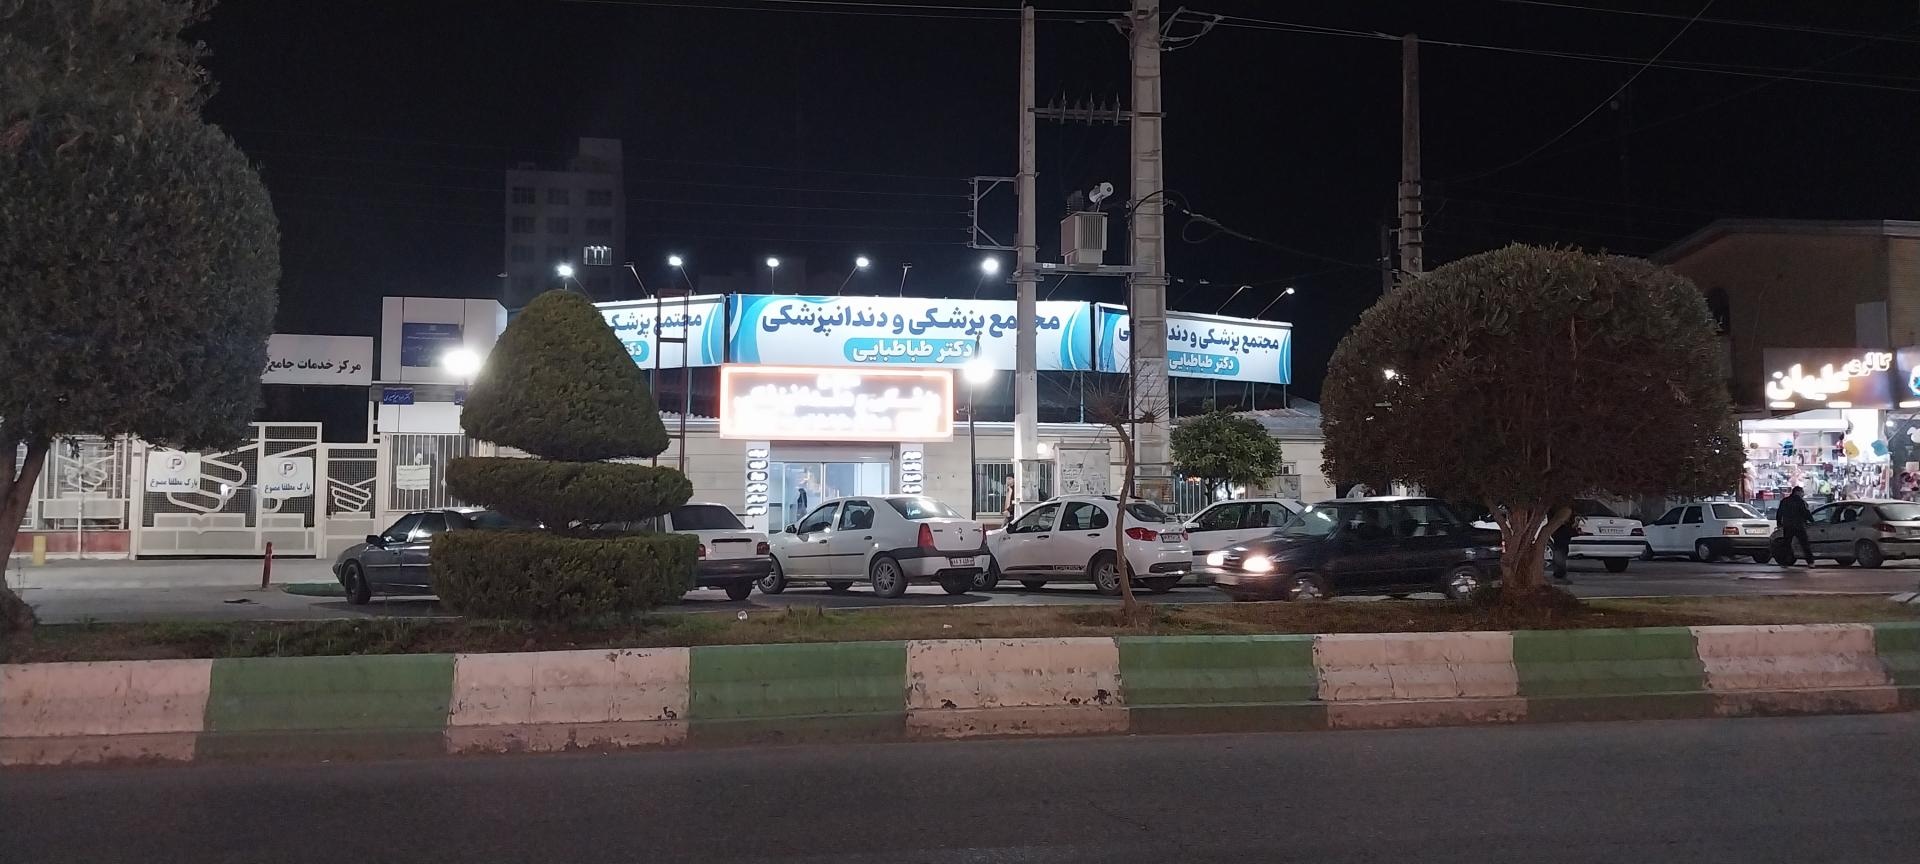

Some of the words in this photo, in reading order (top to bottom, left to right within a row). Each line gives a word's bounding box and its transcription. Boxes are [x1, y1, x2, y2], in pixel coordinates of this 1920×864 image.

[611, 312, 651, 338] پزشک
[653, 312, 702, 336] مجتمع
[762, 303, 889, 337] دندانپزشکی
[892, 313, 905, 335] و
[909, 307, 985, 336] پزشکی
[989, 313, 1060, 338] مجمع
[853, 339, 934, 362] طباطبایی
[1190, 331, 1197, 348] و
[1199, 328, 1240, 354] پزشکی
[1242, 335, 1279, 354] مجتمع
[936, 339, 973, 363] دکتر
[1169, 353, 1213, 371] طباطبایی
[267, 358, 294, 373] جامع
[298, 359, 333, 370] خدمات
[336, 360, 361, 374] مرکز
[1215, 357, 1234, 372] دکتر
[1847, 351, 1892, 377] گالری
[184, 478, 197, 488] پارک
[297, 482, 310, 493] پارک
